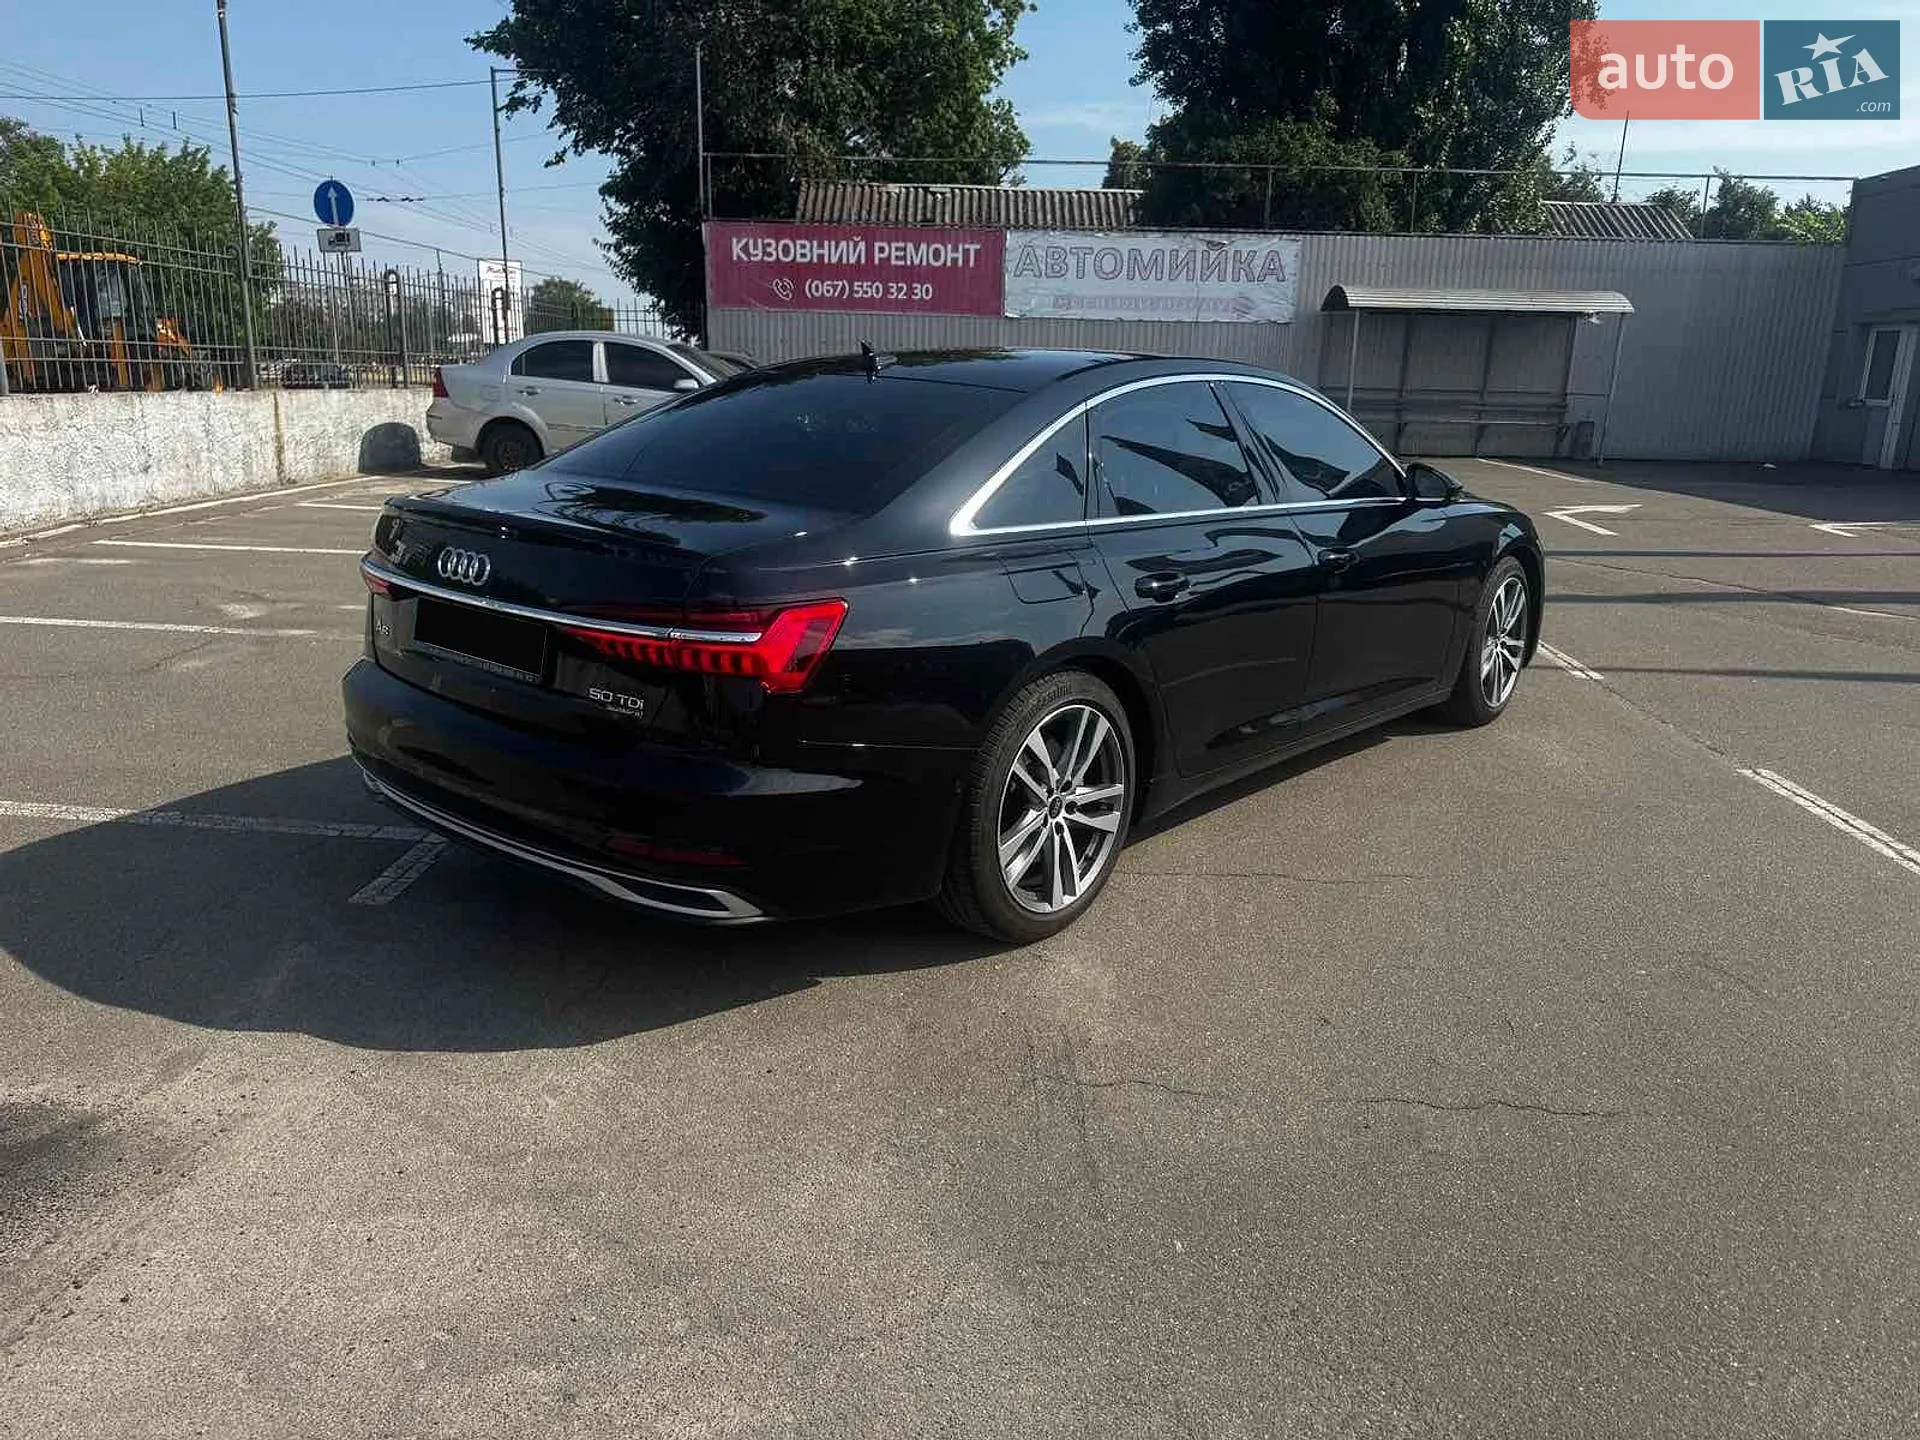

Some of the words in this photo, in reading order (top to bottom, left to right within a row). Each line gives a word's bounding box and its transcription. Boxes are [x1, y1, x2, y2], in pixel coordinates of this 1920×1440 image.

[731, 236, 866, 264] КУЗОВНИЙ
[873, 242, 980, 268] РЕМОНТ
[1013, 240, 1286, 282] АВТОМИЙКА
[804, 278, 850, 298] (067)
[853, 280, 883, 299] 550
[887, 282, 908, 300] 32
[911, 282, 934, 300] 30
[588, 687, 614, 703] 50
